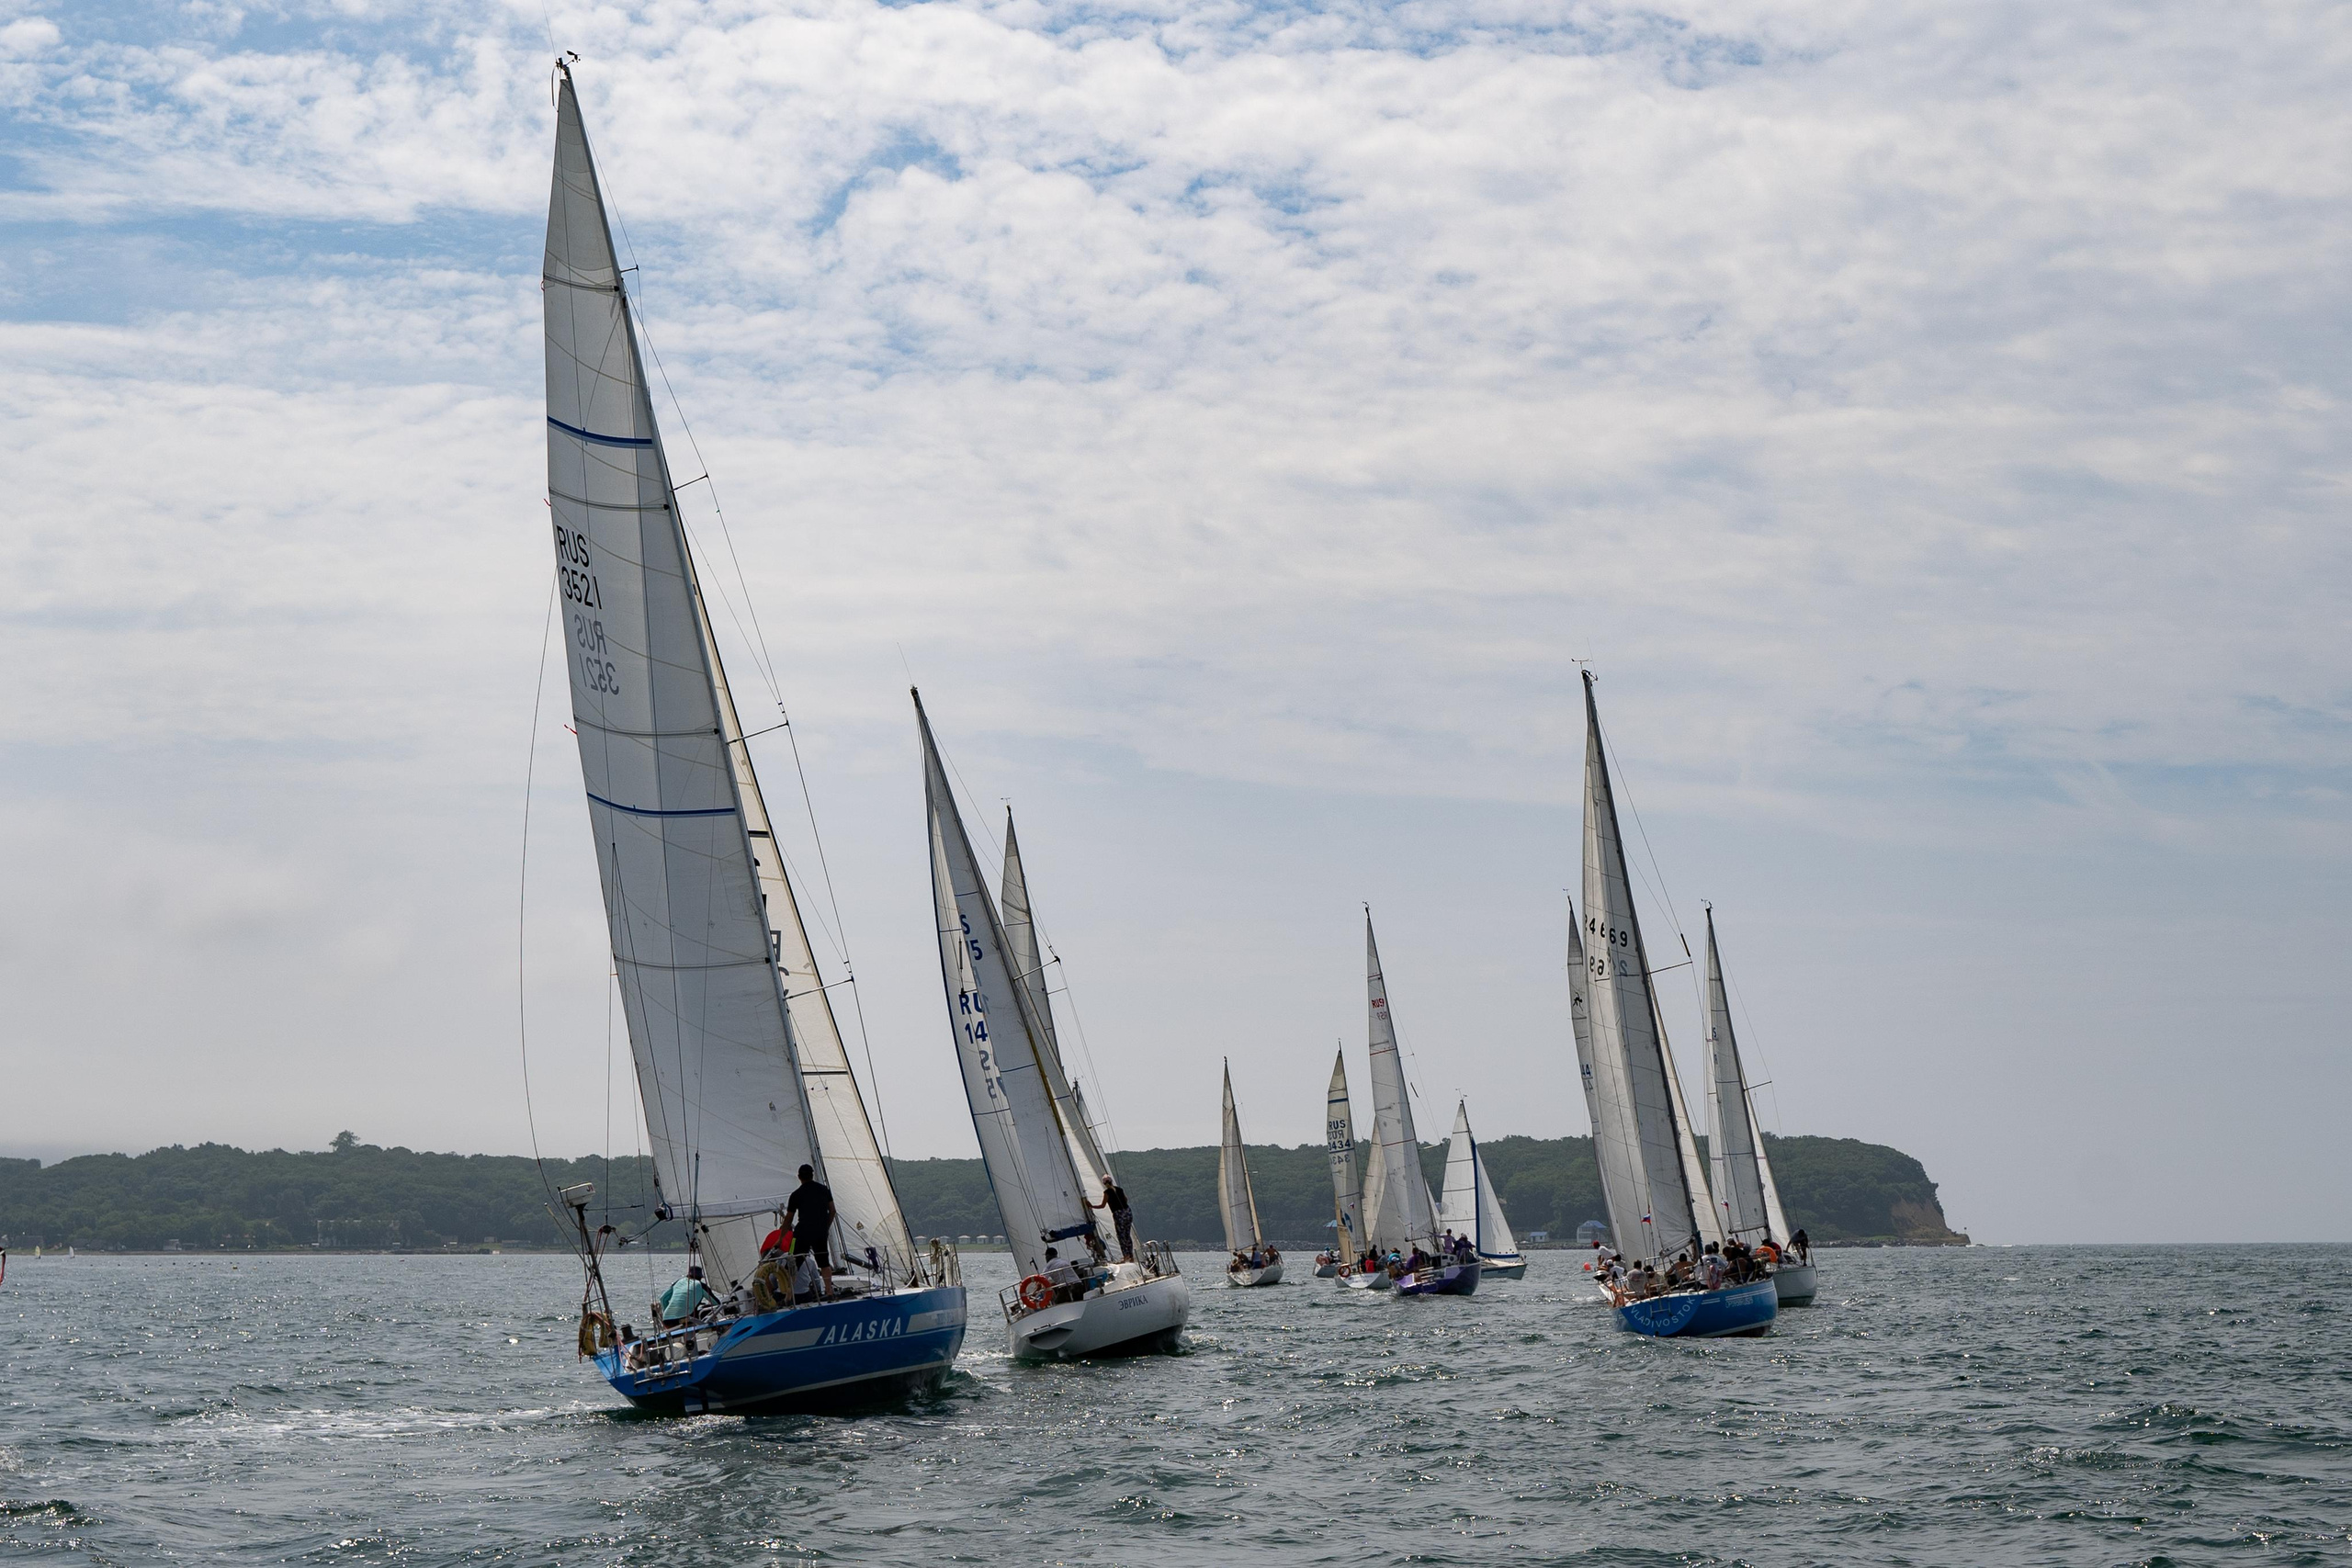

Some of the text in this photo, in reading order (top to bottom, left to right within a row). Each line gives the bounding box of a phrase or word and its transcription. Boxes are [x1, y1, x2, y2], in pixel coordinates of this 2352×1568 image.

[556, 525, 590, 568] RUS
[561, 566, 603, 610] 3521
[1329, 1119, 1346, 1131] RUS
[1118, 1293, 1148, 1311] ЭВРИКА
[1630, 1296, 1696, 1328] VLADIVOSTOK
[823, 1316, 902, 1346] ALASKA
